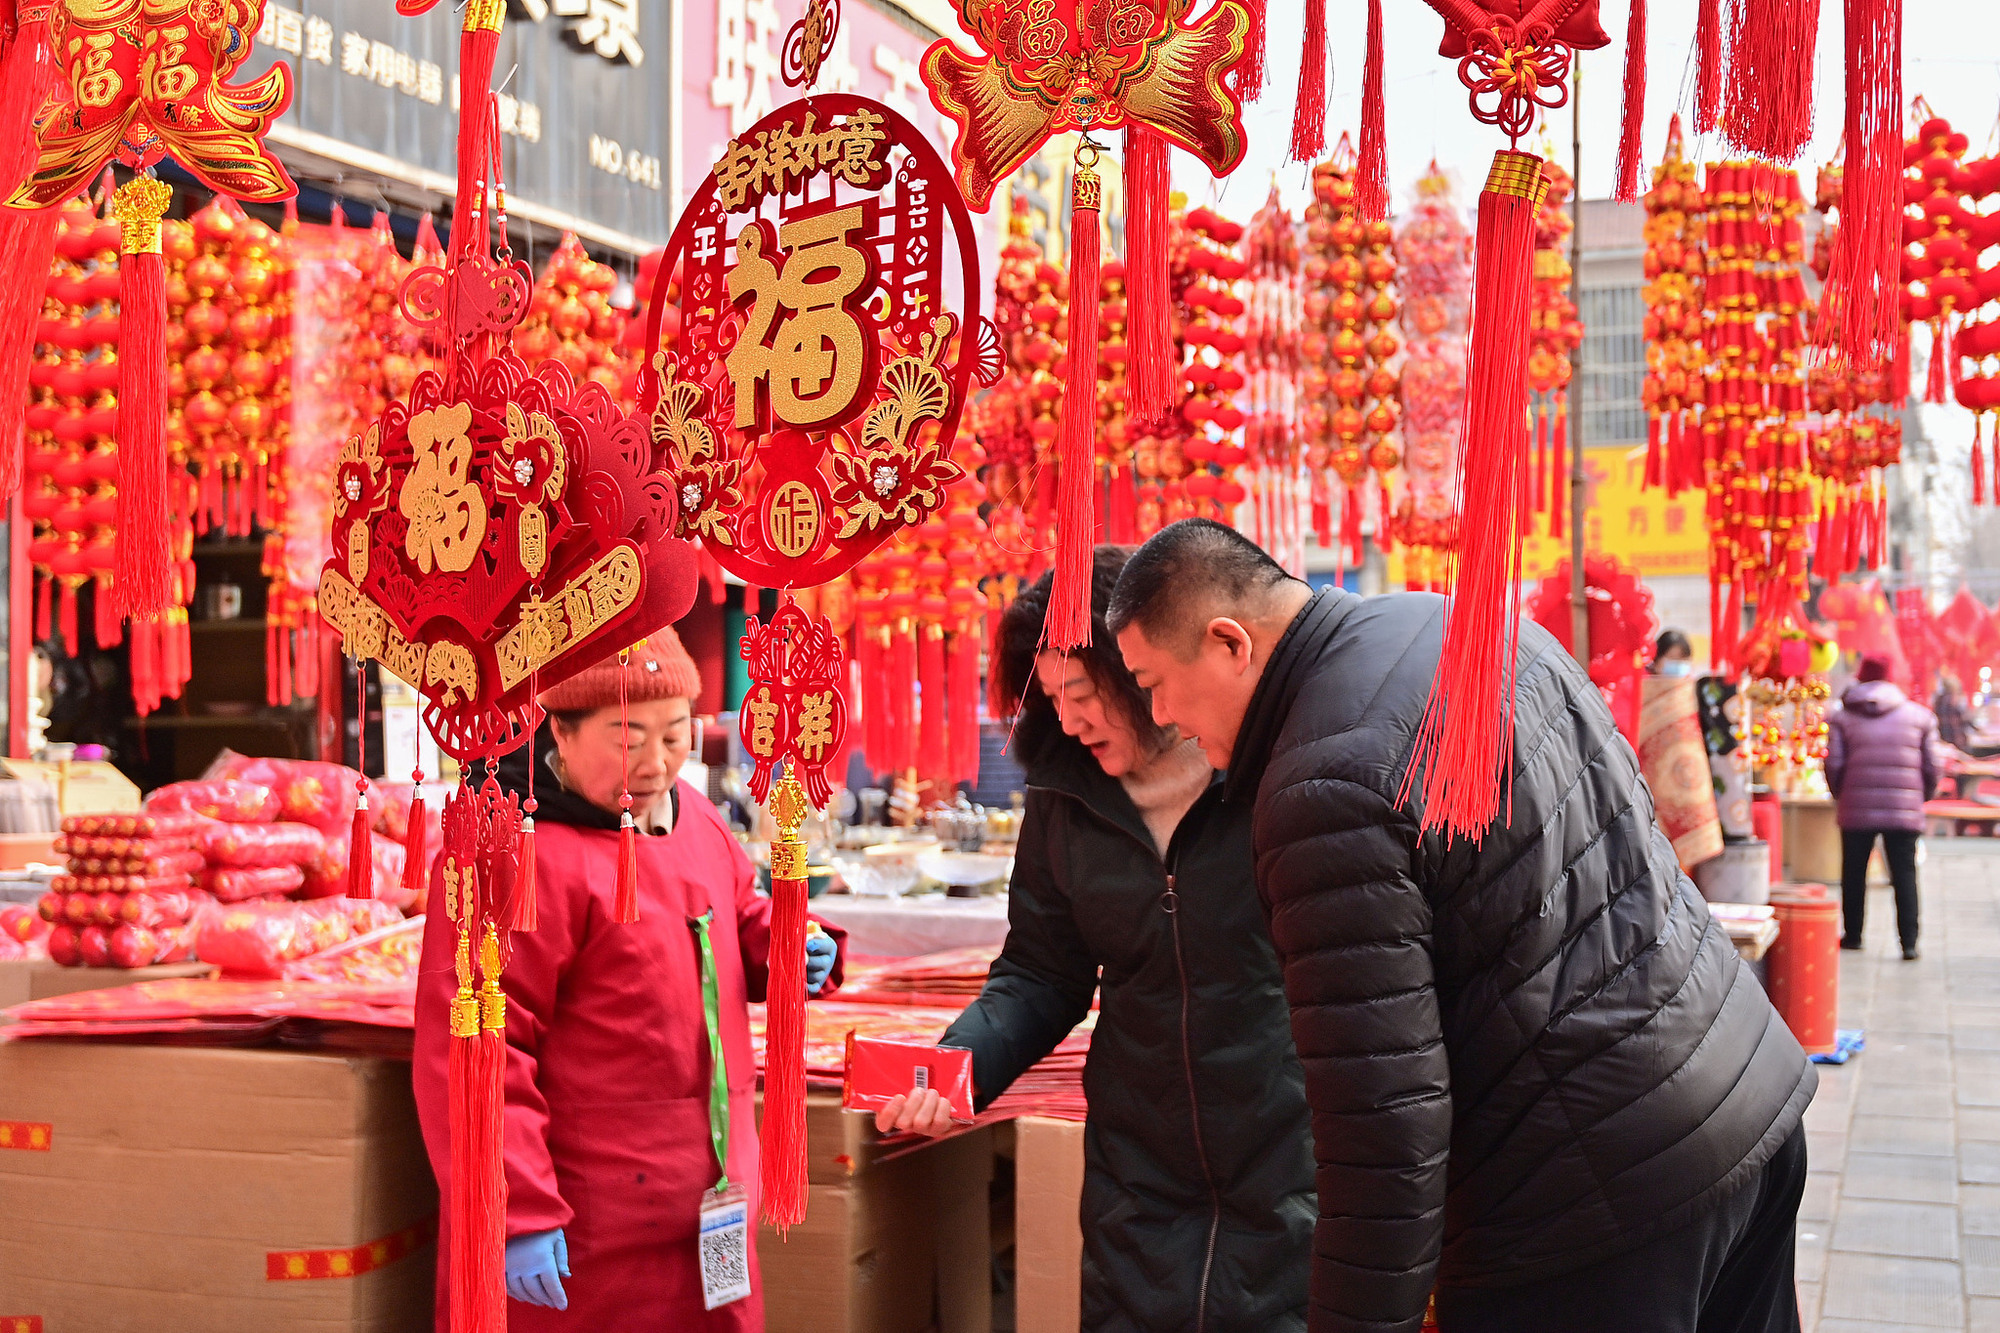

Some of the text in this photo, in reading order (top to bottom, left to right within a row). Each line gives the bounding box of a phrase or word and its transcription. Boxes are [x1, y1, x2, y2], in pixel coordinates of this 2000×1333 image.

[69, 31, 124, 108] 福
[145, 25, 199, 103] 福
[713, 107, 886, 211] 吉祥如意
[725, 205, 867, 430] 福
[399, 400, 488, 575] 福
[772, 483, 817, 556] 福
[750, 686, 834, 764] 吉祥
